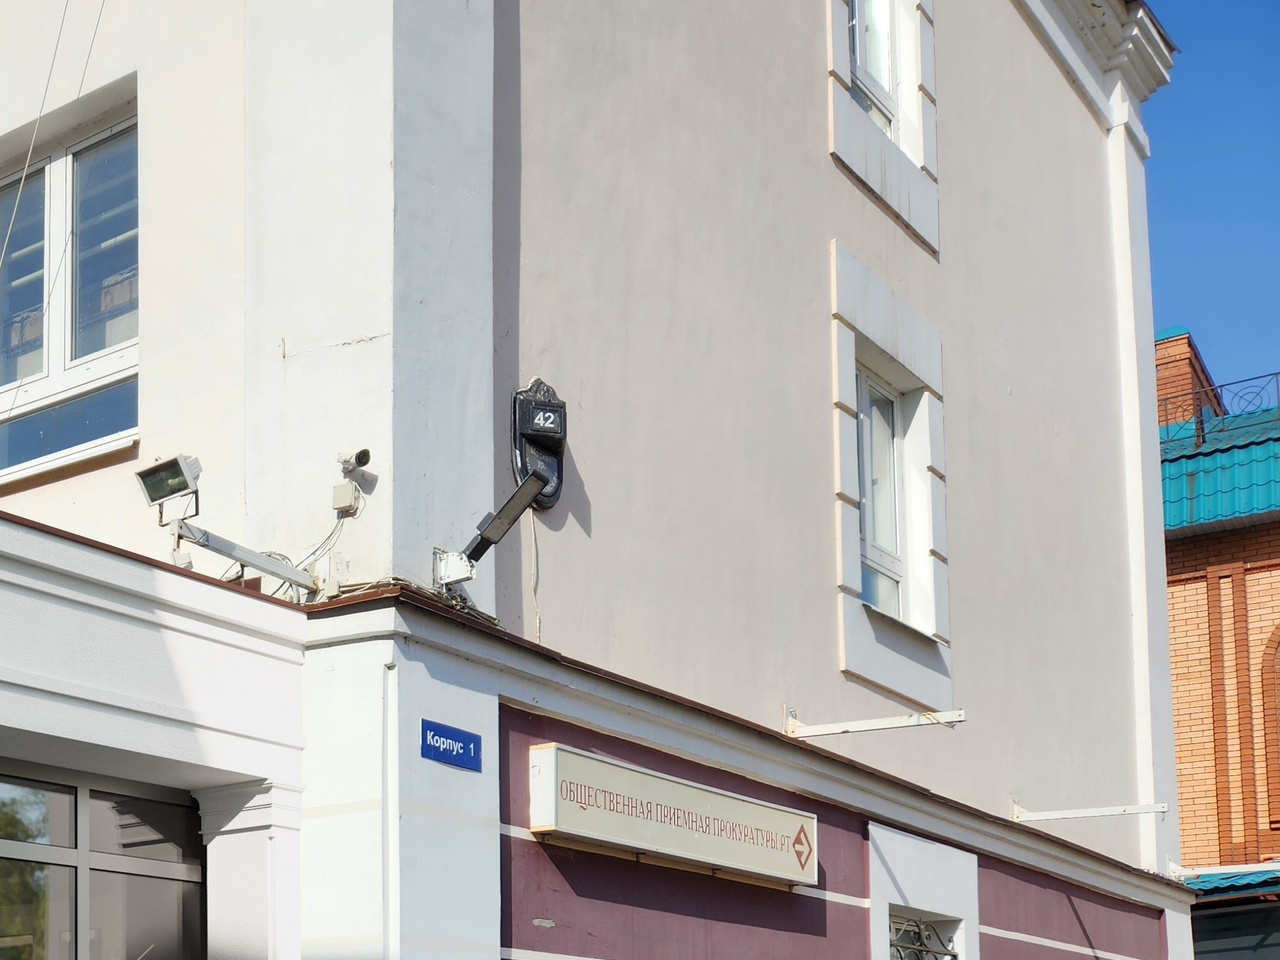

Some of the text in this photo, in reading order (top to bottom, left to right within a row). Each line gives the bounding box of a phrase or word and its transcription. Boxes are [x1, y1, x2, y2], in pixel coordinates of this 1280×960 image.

[534, 412, 554, 428] 42
[426, 730, 474, 757] Корпус 1
[560, 779, 791, 853] ОБЩЕСТВЕННАЯ ПРИЕМНАЯ ПРОКУРАТУРЫ РТ
